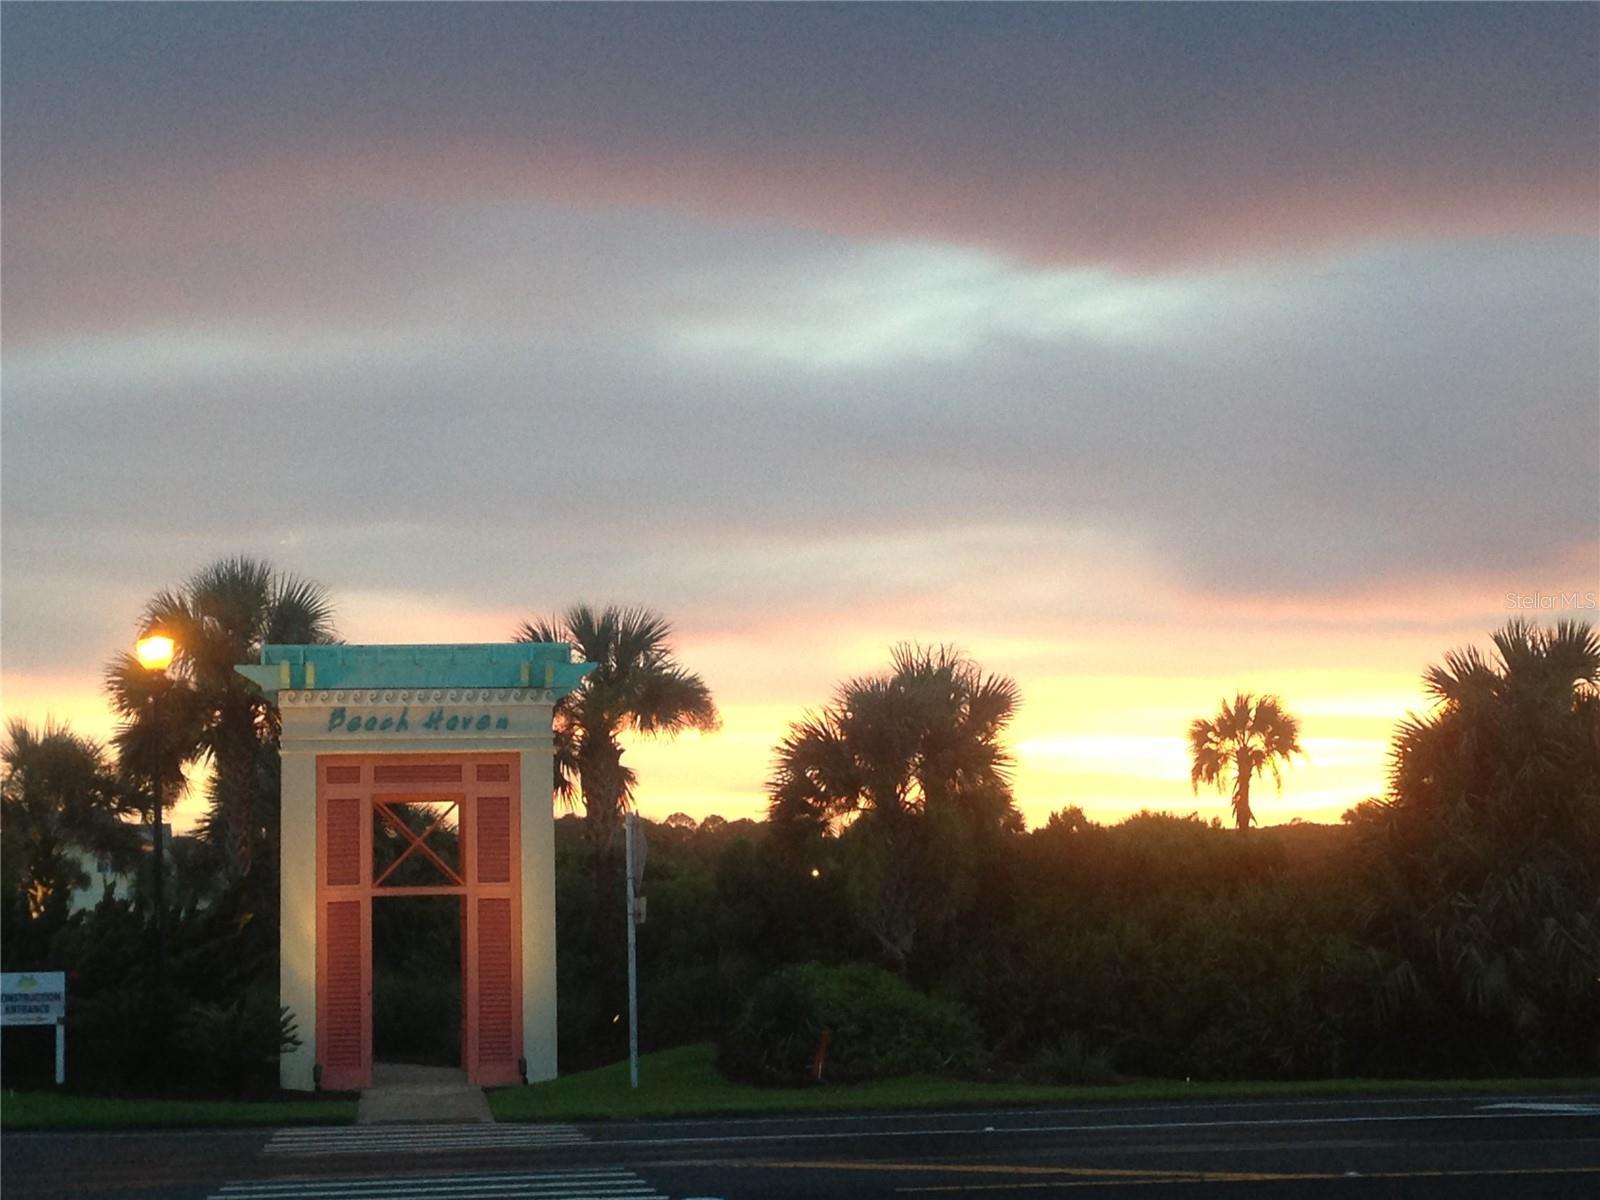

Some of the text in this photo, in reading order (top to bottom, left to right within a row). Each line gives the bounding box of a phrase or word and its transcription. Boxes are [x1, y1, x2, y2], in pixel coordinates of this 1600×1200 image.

[328, 706, 509, 732] Beach Haven
[1, 993, 62, 1003] ONSTRUCTION
